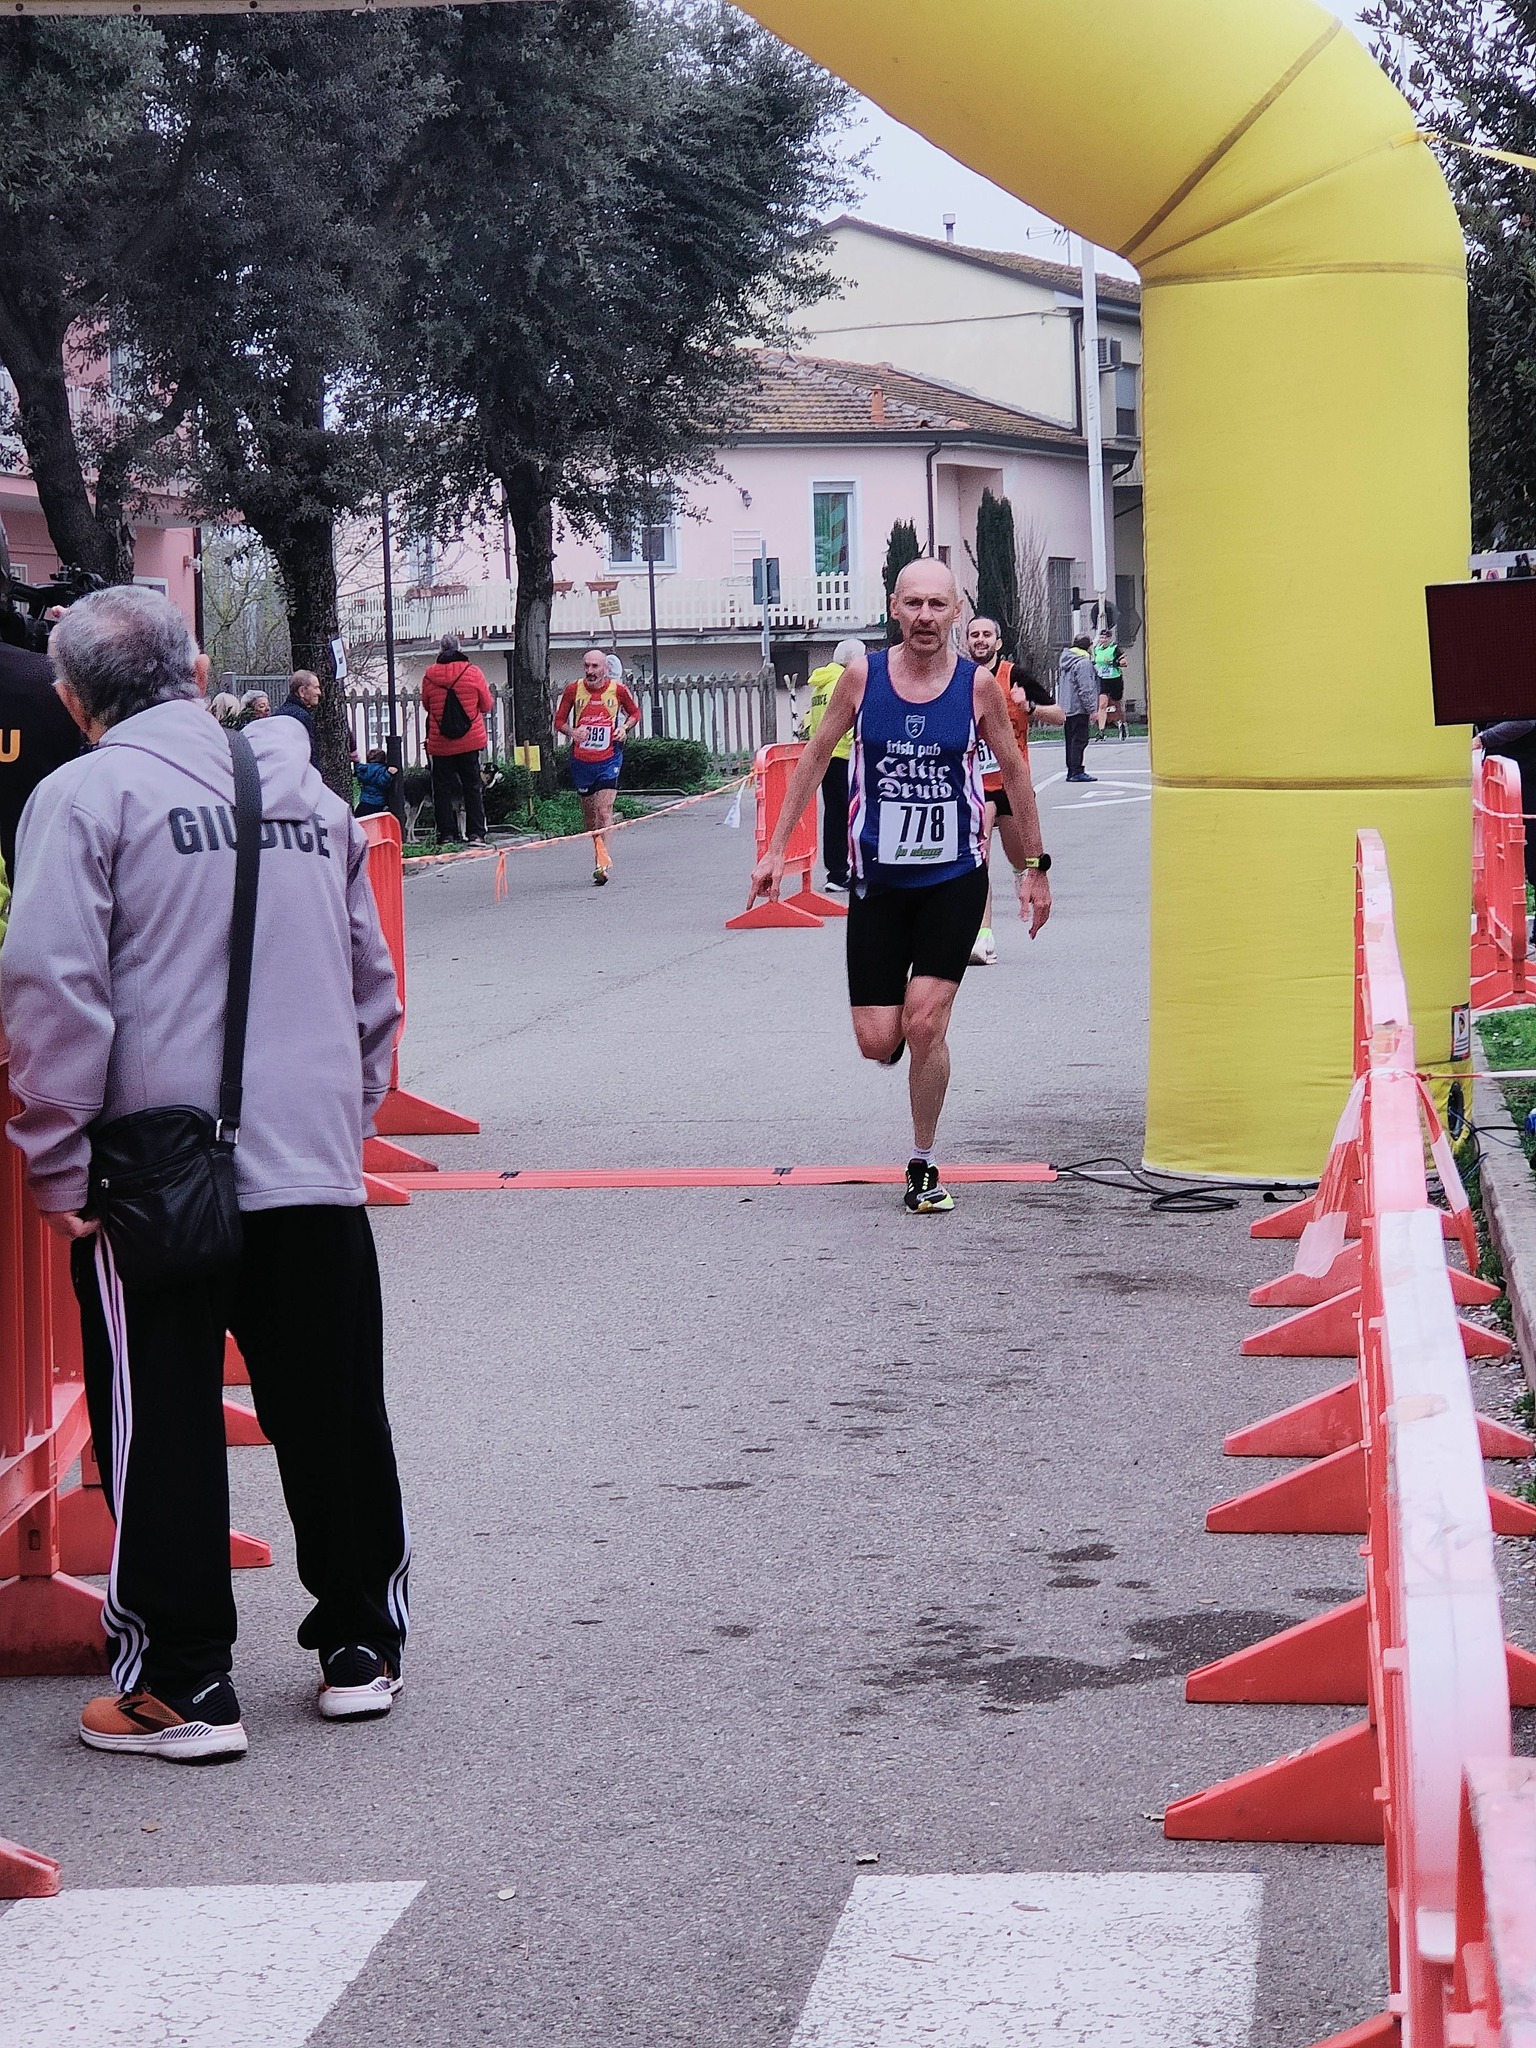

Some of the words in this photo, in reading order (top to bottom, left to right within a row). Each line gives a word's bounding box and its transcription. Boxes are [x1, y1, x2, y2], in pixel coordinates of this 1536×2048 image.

[0, 728, 20, 763] U
[917, 743, 941, 758] pub
[875, 755, 951, 783] Celtic
[877, 777, 953, 800] Druid
[899, 805, 945, 843] 778
